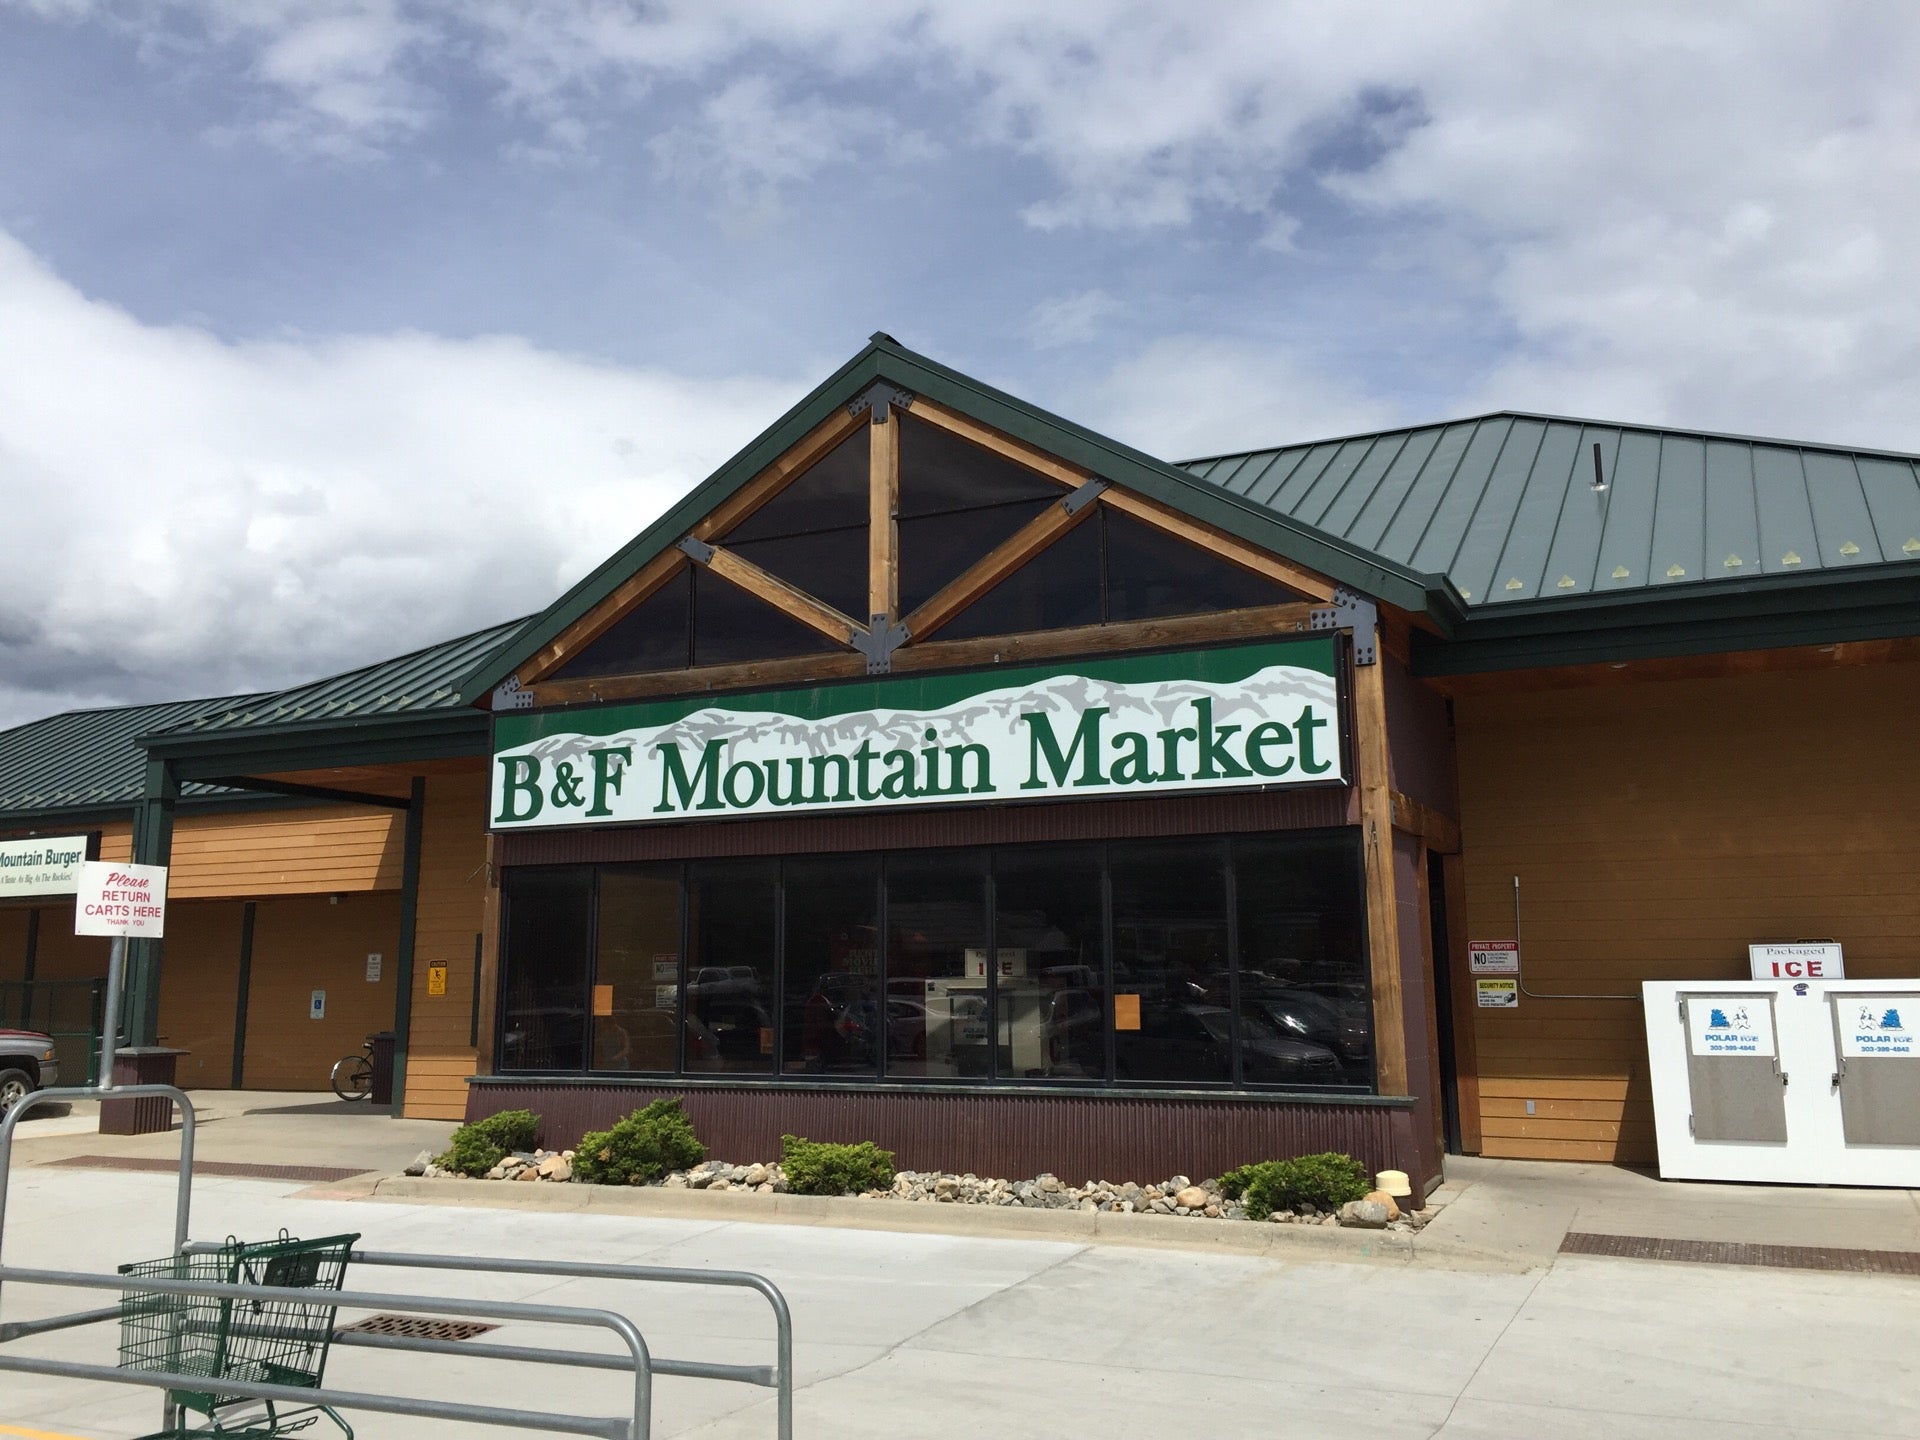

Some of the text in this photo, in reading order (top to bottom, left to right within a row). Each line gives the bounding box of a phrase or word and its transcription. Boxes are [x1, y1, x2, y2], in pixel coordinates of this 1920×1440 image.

[494, 696, 1332, 823] B&F Mountain Market
[45, 849, 82, 868] Burger
[105, 872, 150, 888] Please
[102, 890, 151, 903] RETURN
[85, 904, 161, 918] CARTS HERE
[106, 918, 129, 926] THANK
[1766, 947, 1826, 956] Packaged
[1474, 952, 1487, 965] NO
[978, 962, 1013, 976] IE
[1771, 961, 1824, 977] ICE
[1705, 1034, 1738, 1042] POLAR
[1855, 1035, 1890, 1043] POLAR
